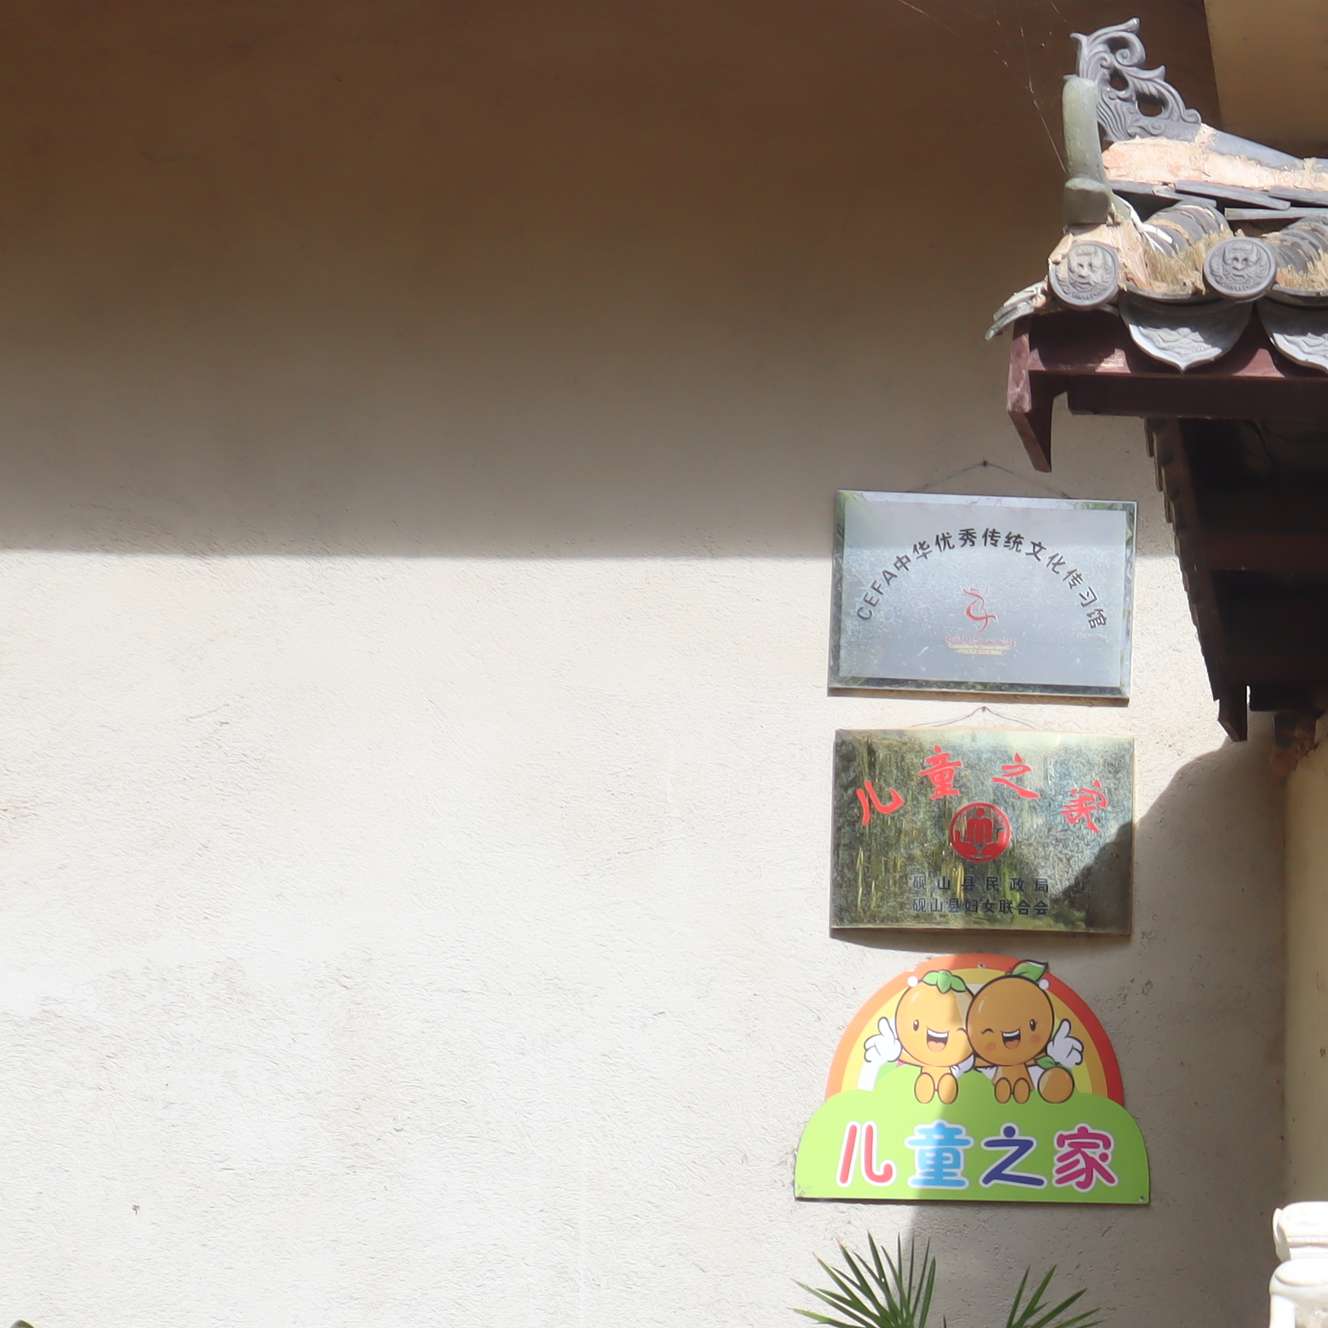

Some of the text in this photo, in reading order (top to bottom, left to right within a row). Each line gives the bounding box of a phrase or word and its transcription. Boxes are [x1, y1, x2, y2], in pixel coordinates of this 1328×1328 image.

[856, 528, 1108, 630] CEFA中华优秀传统文化传习馆
[854, 743, 1110, 834] 儿童之家
[911, 874, 1050, 893] 砚山县民政局
[911, 898, 1050, 916] 砚山县妇女联合会
[838, 1121, 1117, 1190] 儿童之家
